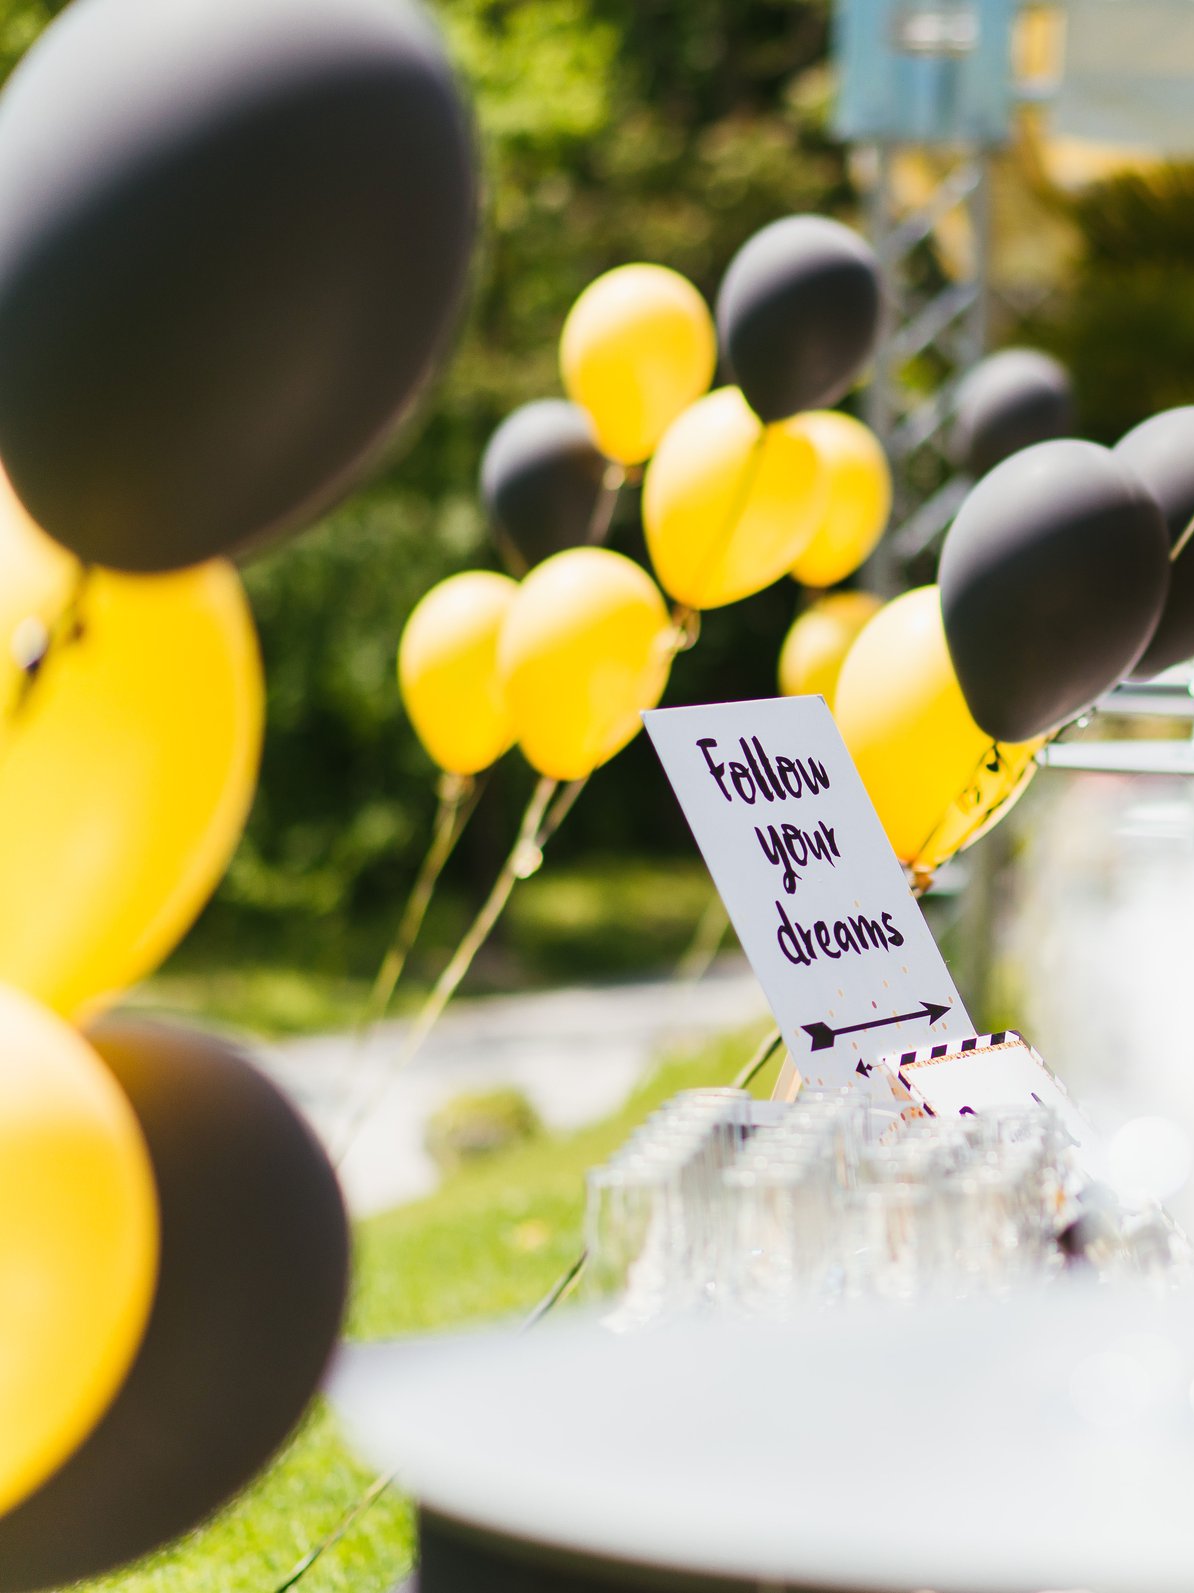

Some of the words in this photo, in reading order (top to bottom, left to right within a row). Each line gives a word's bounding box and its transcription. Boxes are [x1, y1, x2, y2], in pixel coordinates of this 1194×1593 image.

[696, 736, 830, 804] Follow
[754, 820, 841, 894] your
[775, 901, 904, 966] dreams
